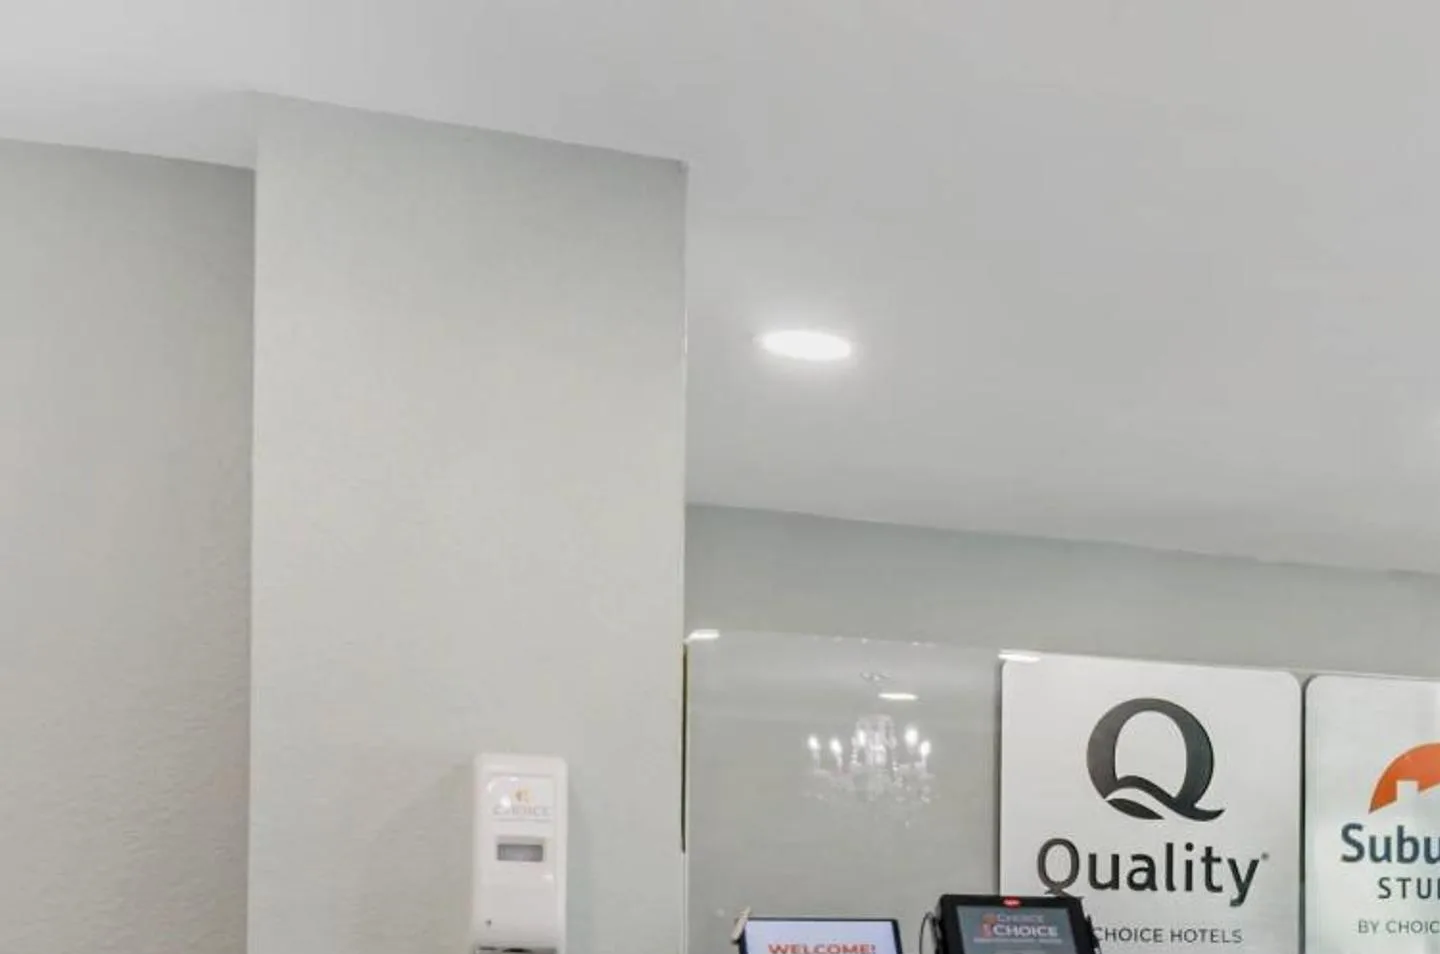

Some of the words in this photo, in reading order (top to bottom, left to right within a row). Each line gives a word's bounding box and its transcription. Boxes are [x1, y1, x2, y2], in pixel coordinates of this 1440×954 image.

[1037, 838, 1260, 907] Quality
[993, 923, 1059, 938] CHOICE
[1096, 926, 1164, 944] CHOICE
[1169, 927, 1243, 945] HOTELS
[1357, 919, 1380, 935] BY
